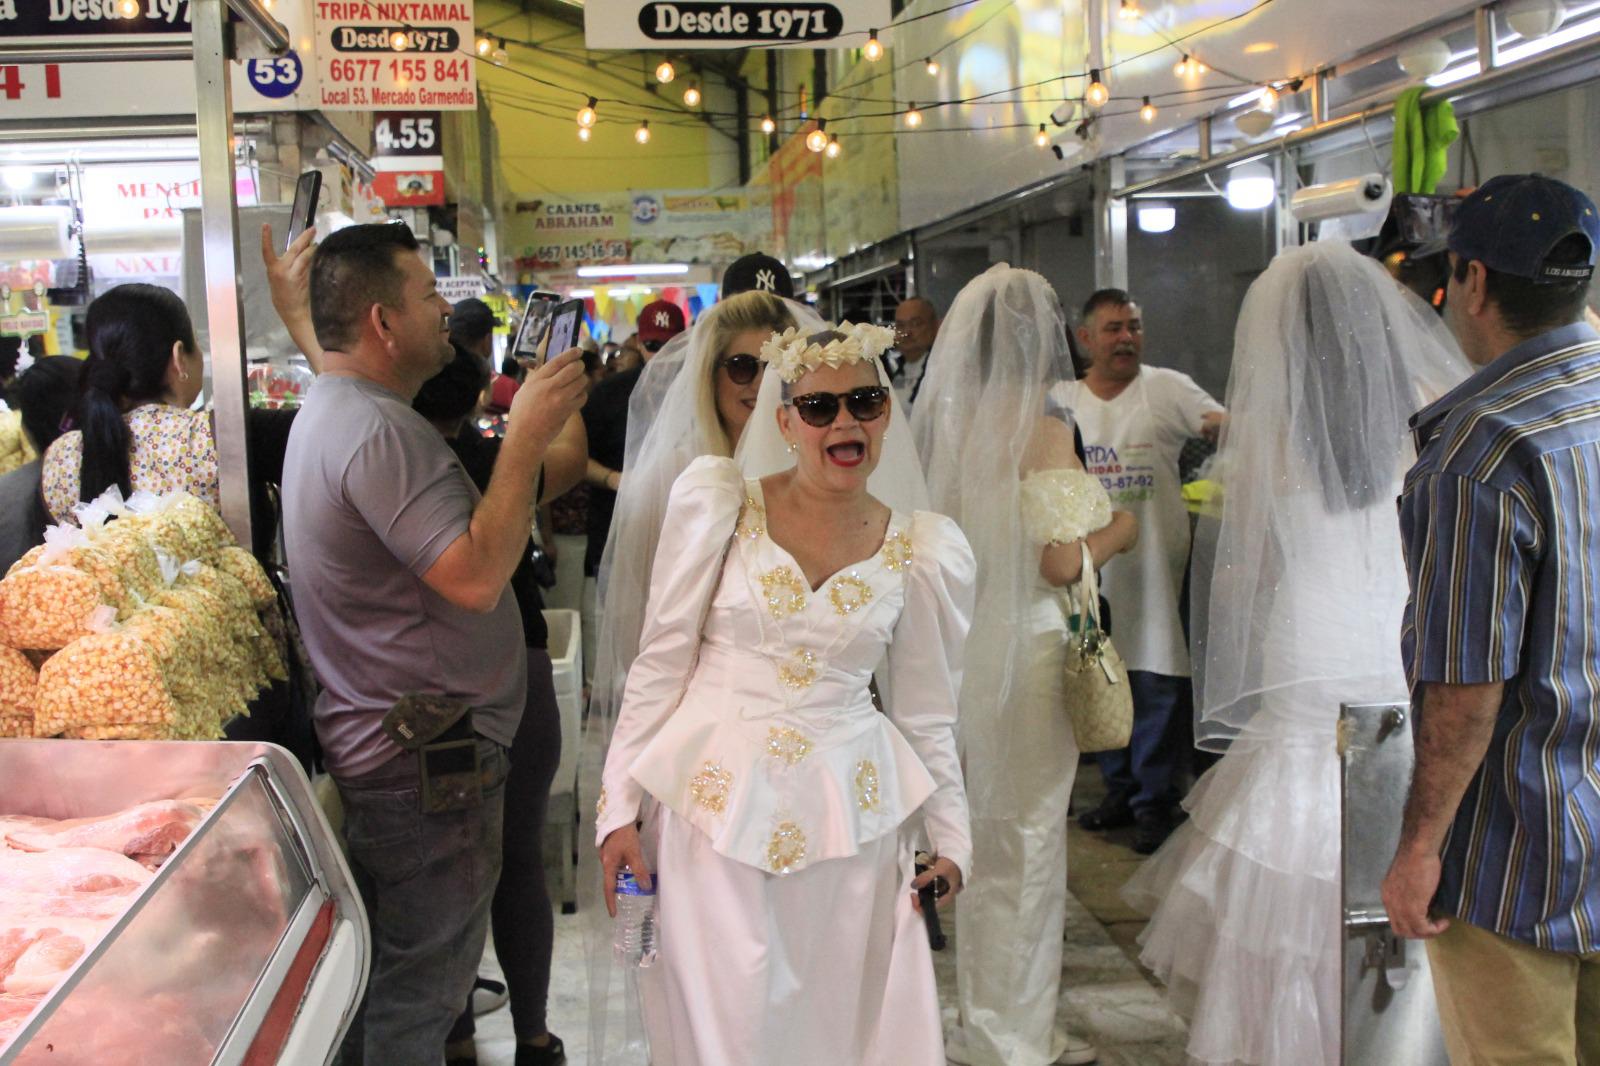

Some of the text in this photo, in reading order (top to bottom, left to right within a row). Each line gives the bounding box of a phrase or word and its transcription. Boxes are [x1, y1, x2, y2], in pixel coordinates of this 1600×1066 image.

[49, 0, 139, 21] Desd
[318, 2, 470, 21] TRIPA NIXTAMAL
[655, 5, 828, 37] Desde 1971
[341, 28, 449, 51] Desd 1971
[255, 58, 297, 85] 53
[330, 59, 470, 82] 6677 155 841
[321, 88, 350, 104] Local
[372, 88, 416, 104] Mercado
[419, 88, 474, 105] Garmendia
[375, 118, 435, 149] 4.55
[547, 203, 601, 215] CARNES
[535, 215, 614, 230] ABRAHAM
[565, 245, 585, 259] 145
[756, 269, 775, 291] NY
[1544, 267, 1590, 278] LOS ANGELES
